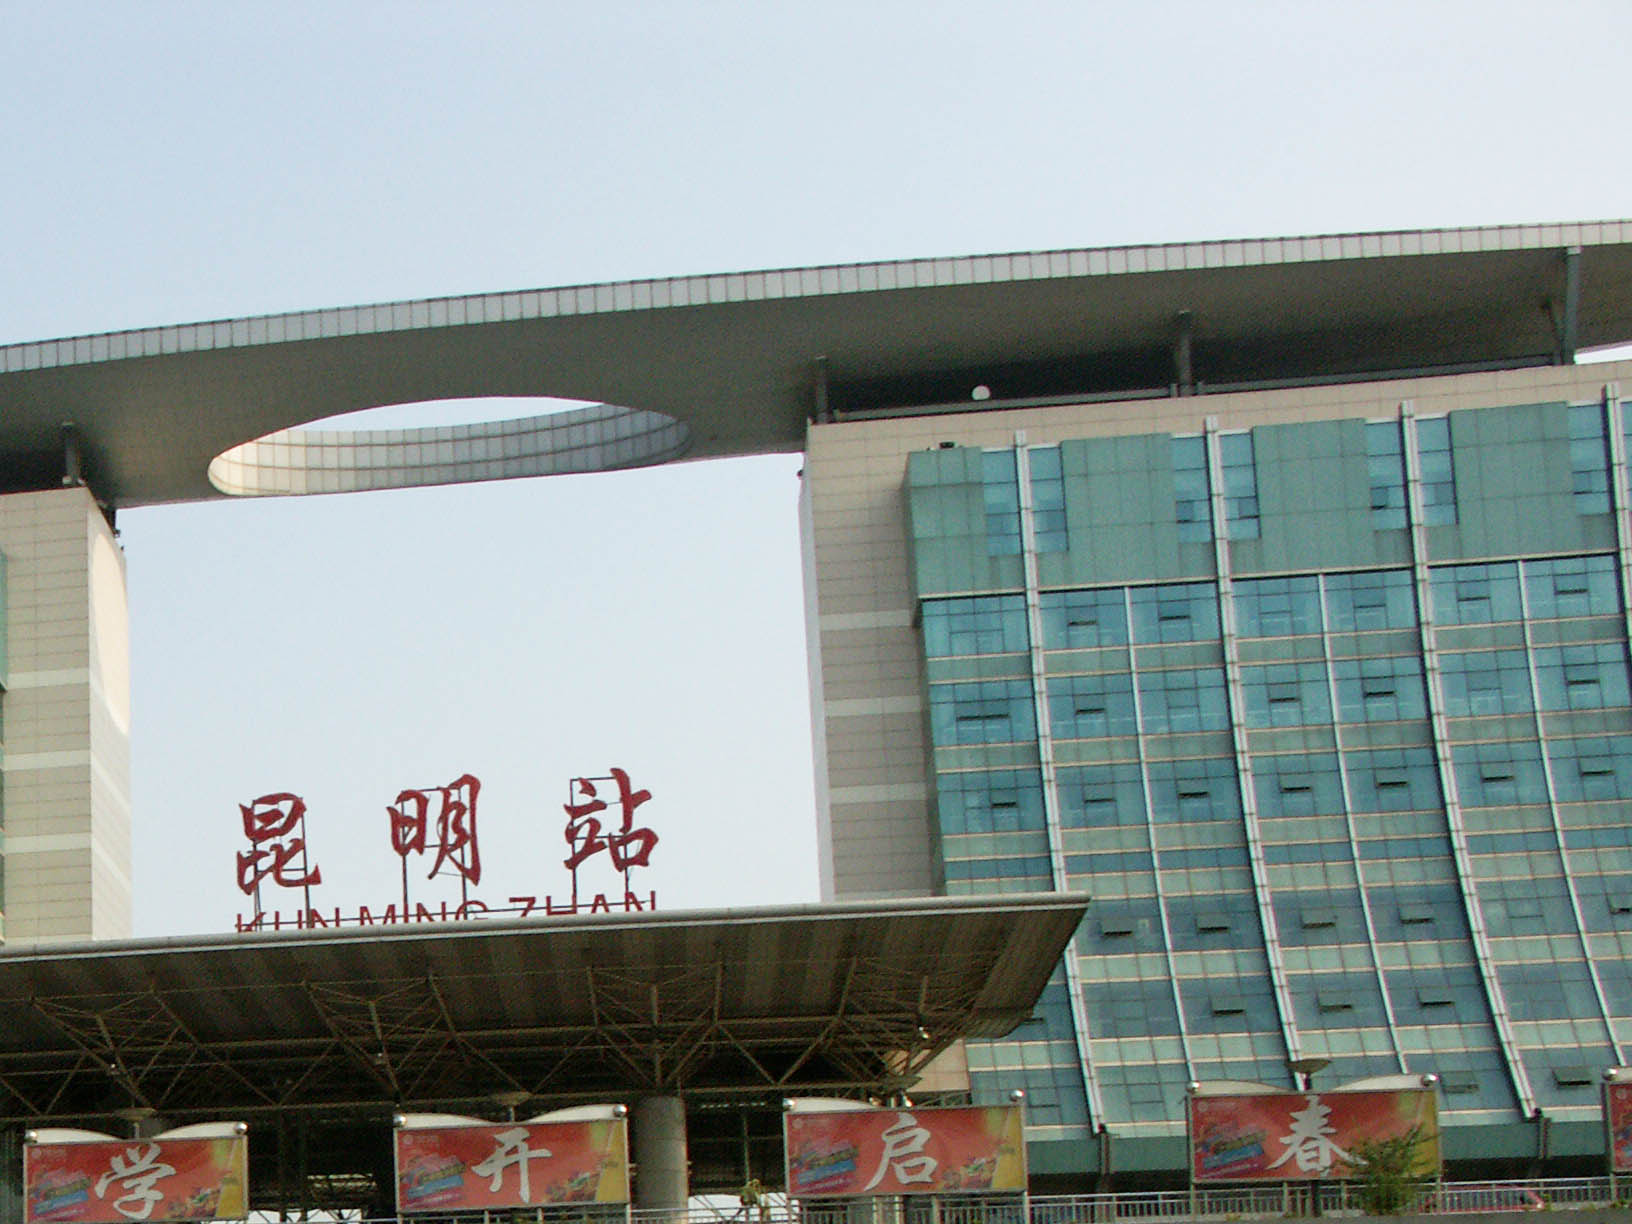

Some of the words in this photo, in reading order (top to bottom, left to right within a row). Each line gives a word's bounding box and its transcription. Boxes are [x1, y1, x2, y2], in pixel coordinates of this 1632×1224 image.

[237, 768, 659, 896] 昆明站
[471, 1127, 553, 1203] 开
[866, 1113, 938, 1191] 启
[1267, 1095, 1368, 1177] 春
[94, 1143, 175, 1220] 学
